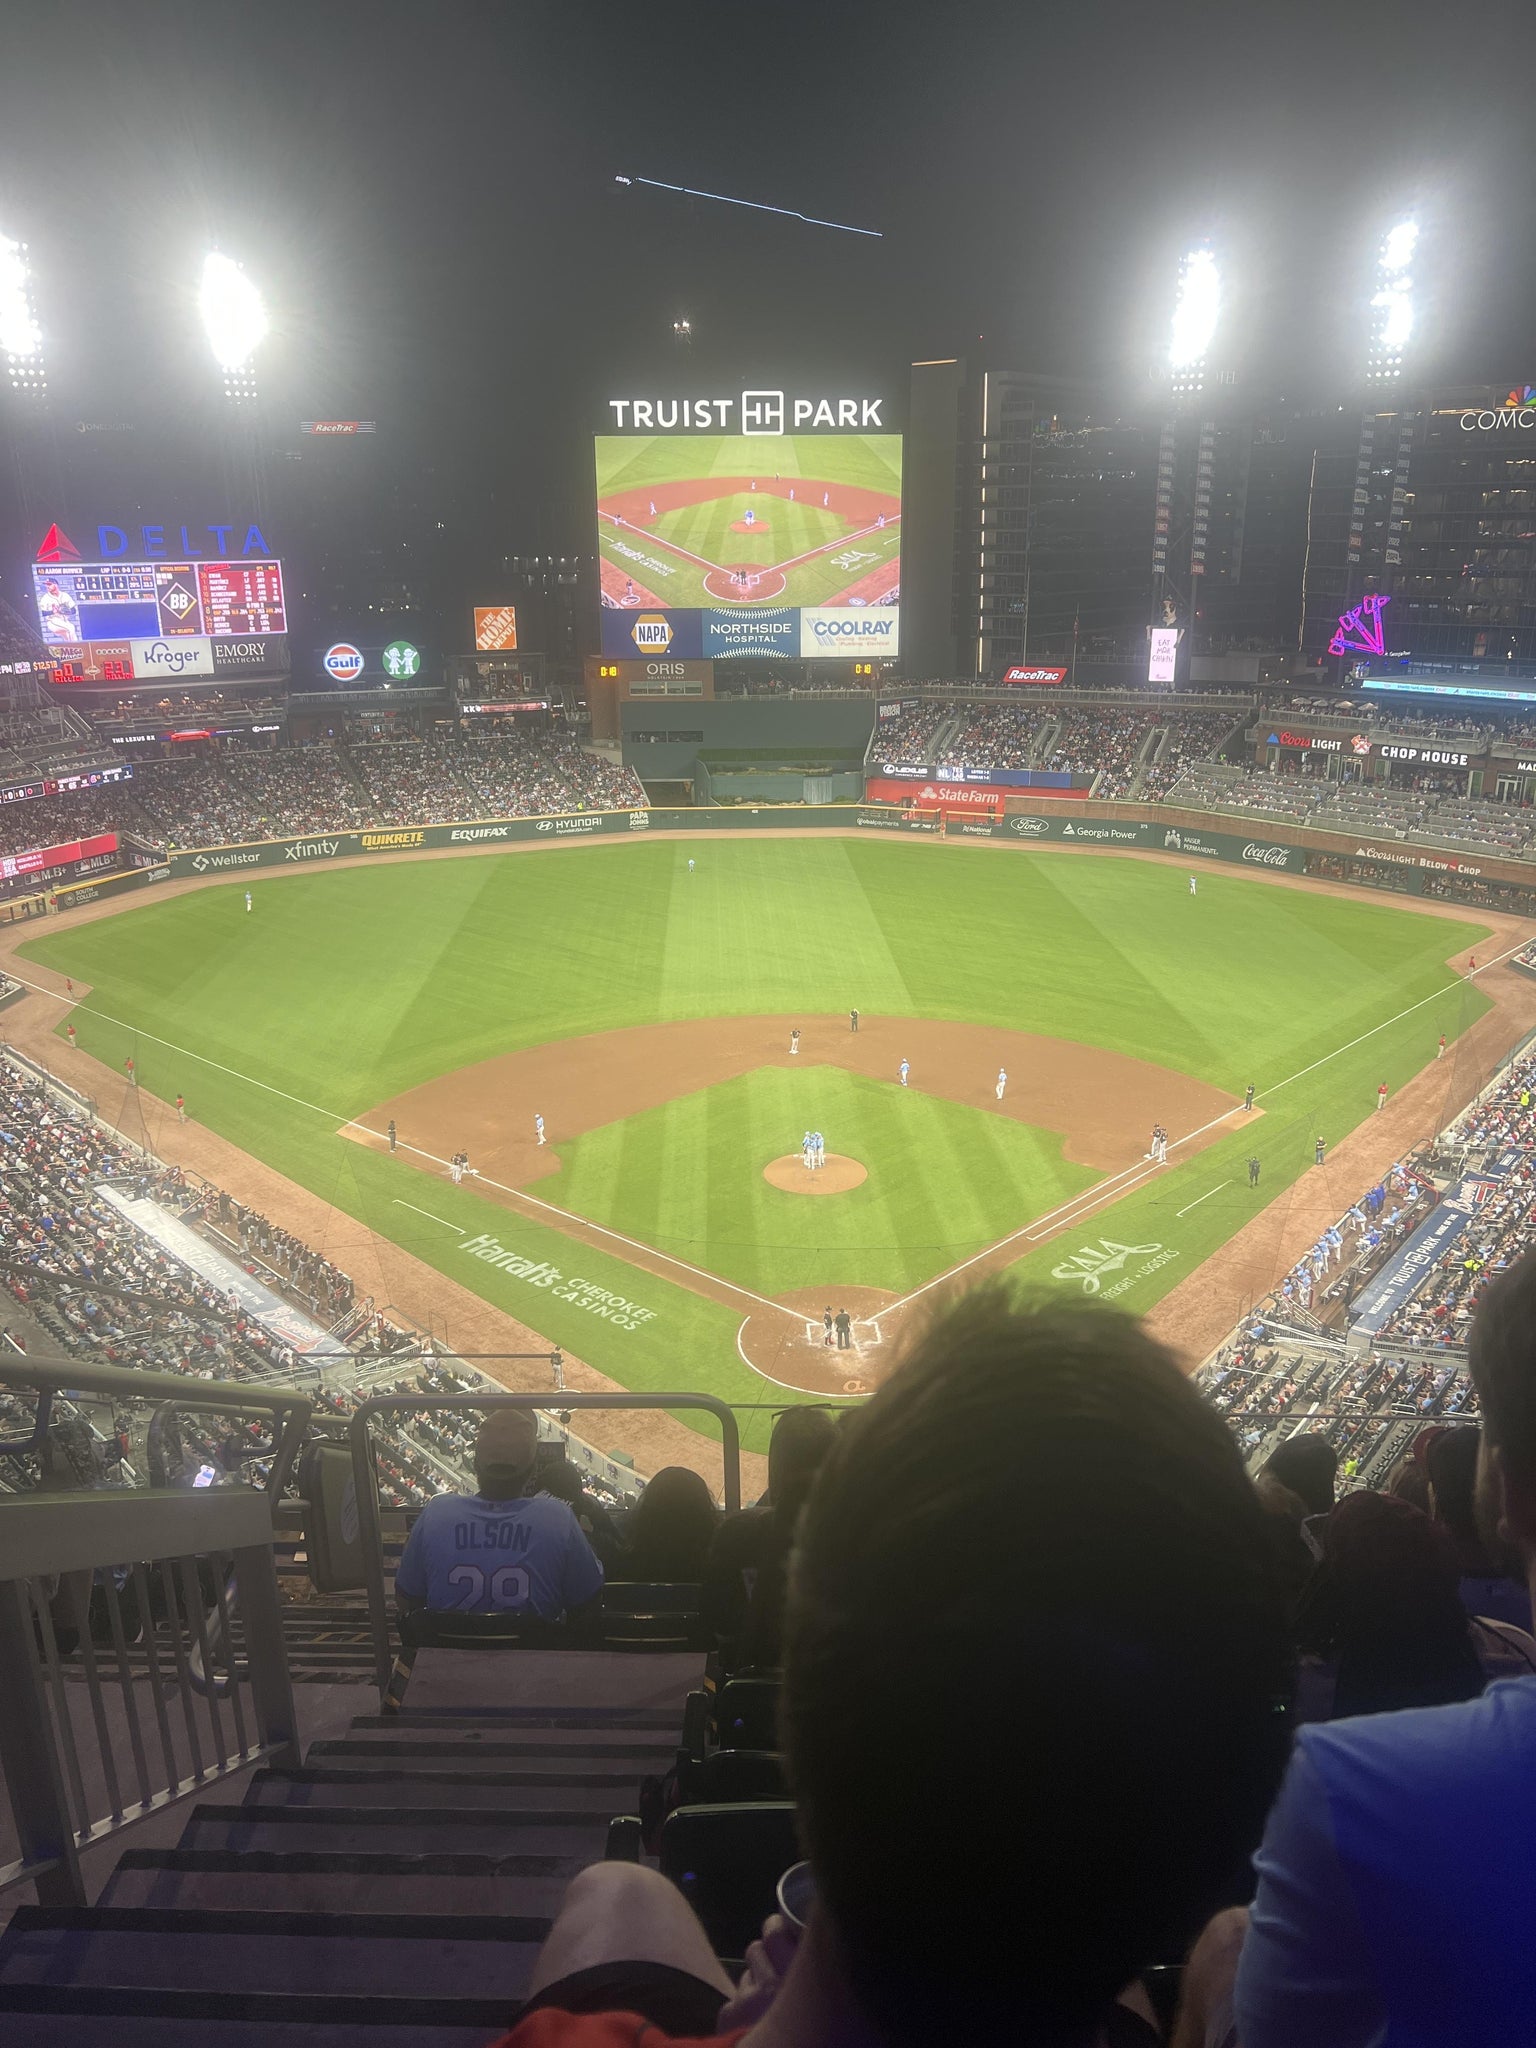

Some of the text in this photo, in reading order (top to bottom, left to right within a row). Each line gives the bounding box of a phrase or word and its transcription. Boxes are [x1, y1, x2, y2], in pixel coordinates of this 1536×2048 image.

[609, 399, 883, 428] TRUIST PARK
[1460, 408, 1536, 431] COMC
[315, 424, 354, 433] RaceTrac
[97, 525, 271, 558] DELTA
[170, 593, 189, 610] BB
[477, 607, 515, 650] HOME
[480, 612, 496, 629] THE
[710, 623, 792, 634] NORTHSIDE
[814, 620, 894, 636] COOLRAY
[492, 622, 516, 650] DEPOT
[638, 625, 667, 643] NAPA
[726, 635, 777, 643] HOSPITAL
[215, 643, 266, 657] EMORY
[1158, 639, 1170, 647] EAT
[144, 642, 200, 672] Kroger
[327, 656, 361, 668] Gulf
[646, 663, 685, 675] ORIS
[1009, 669, 1059, 680] RaceTrac
[126, 735, 145, 743] LEXUS
[1280, 731, 1342, 751] Coors LIGHT
[1381, 746, 1468, 766] CHOP HOUSE
[938, 787, 999, 803] State Farm
[556, 817, 602, 829] HYUNDAI
[630, 811, 648, 820] PAPA
[1017, 819, 1042, 831] Ford
[362, 831, 425, 847] QUIKRETE
[451, 827, 508, 842] EQUIFAX
[1077, 827, 1137, 840] Georgia Power
[1183, 837, 1201, 845] KAISER
[284, 839, 340, 861] xfinity
[90, 854, 116, 868] MLB+
[211, 852, 260, 867] Wellstar
[1366, 847, 1481, 876] Coors LIGHT BELOW CHOP
[76, 887, 94, 896] SOUTH
[76, 891, 99, 902] COLLEGE
[458, 1233, 563, 1288] Harrah's
[1388, 1262, 1419, 1287] TRUIST
[1416, 1236, 1440, 1255] PARK
[208, 1259, 233, 1281] PARK
[1100, 1248, 1180, 1300] FREIGHT LOGISTICS
[551, 1285, 642, 1330] CASINOS
[567, 1278, 658, 1323] CHEROKEE
[455, 1520, 532, 1553] OLSON
